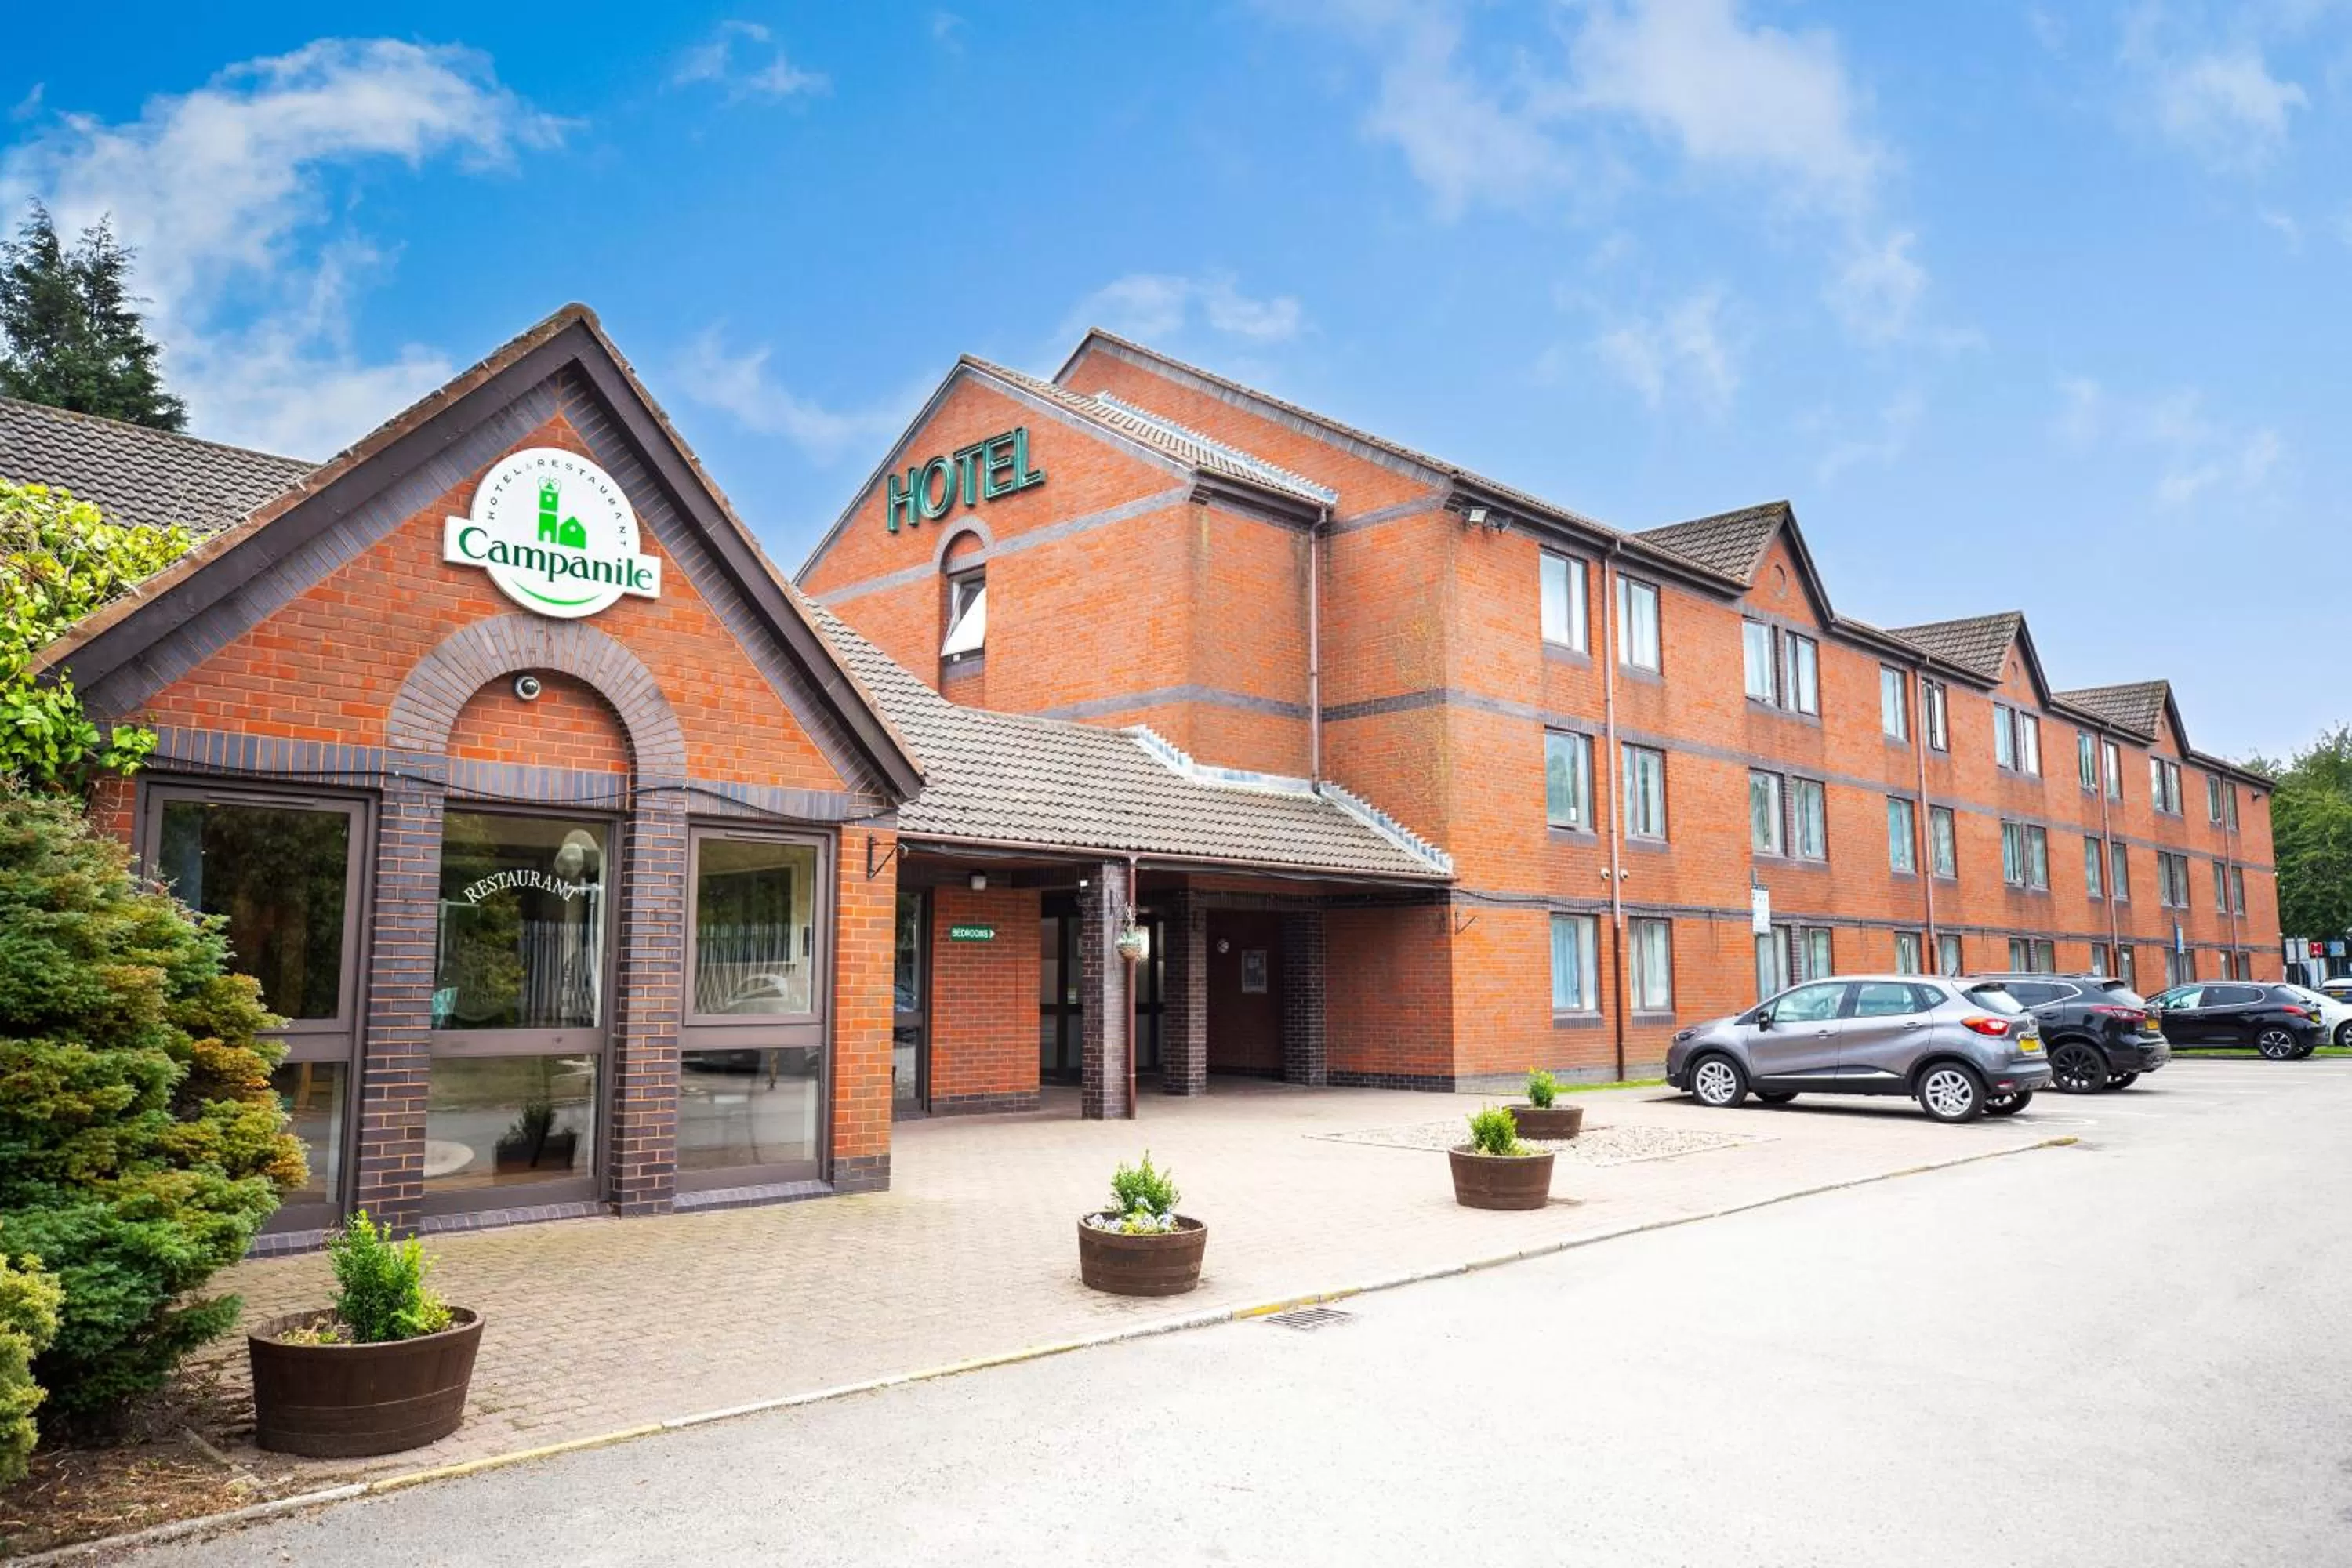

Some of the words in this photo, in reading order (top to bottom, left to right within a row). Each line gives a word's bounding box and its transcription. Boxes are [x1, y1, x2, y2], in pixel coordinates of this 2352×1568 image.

[487, 468, 522, 521] HOTEL
[537, 459, 626, 546] RESTAURANT
[887, 426, 1046, 532] HOTEL
[459, 526, 653, 590] Campanile
[463, 869, 579, 902] RESTAURANT
[952, 928, 989, 938] BEDROOMS
